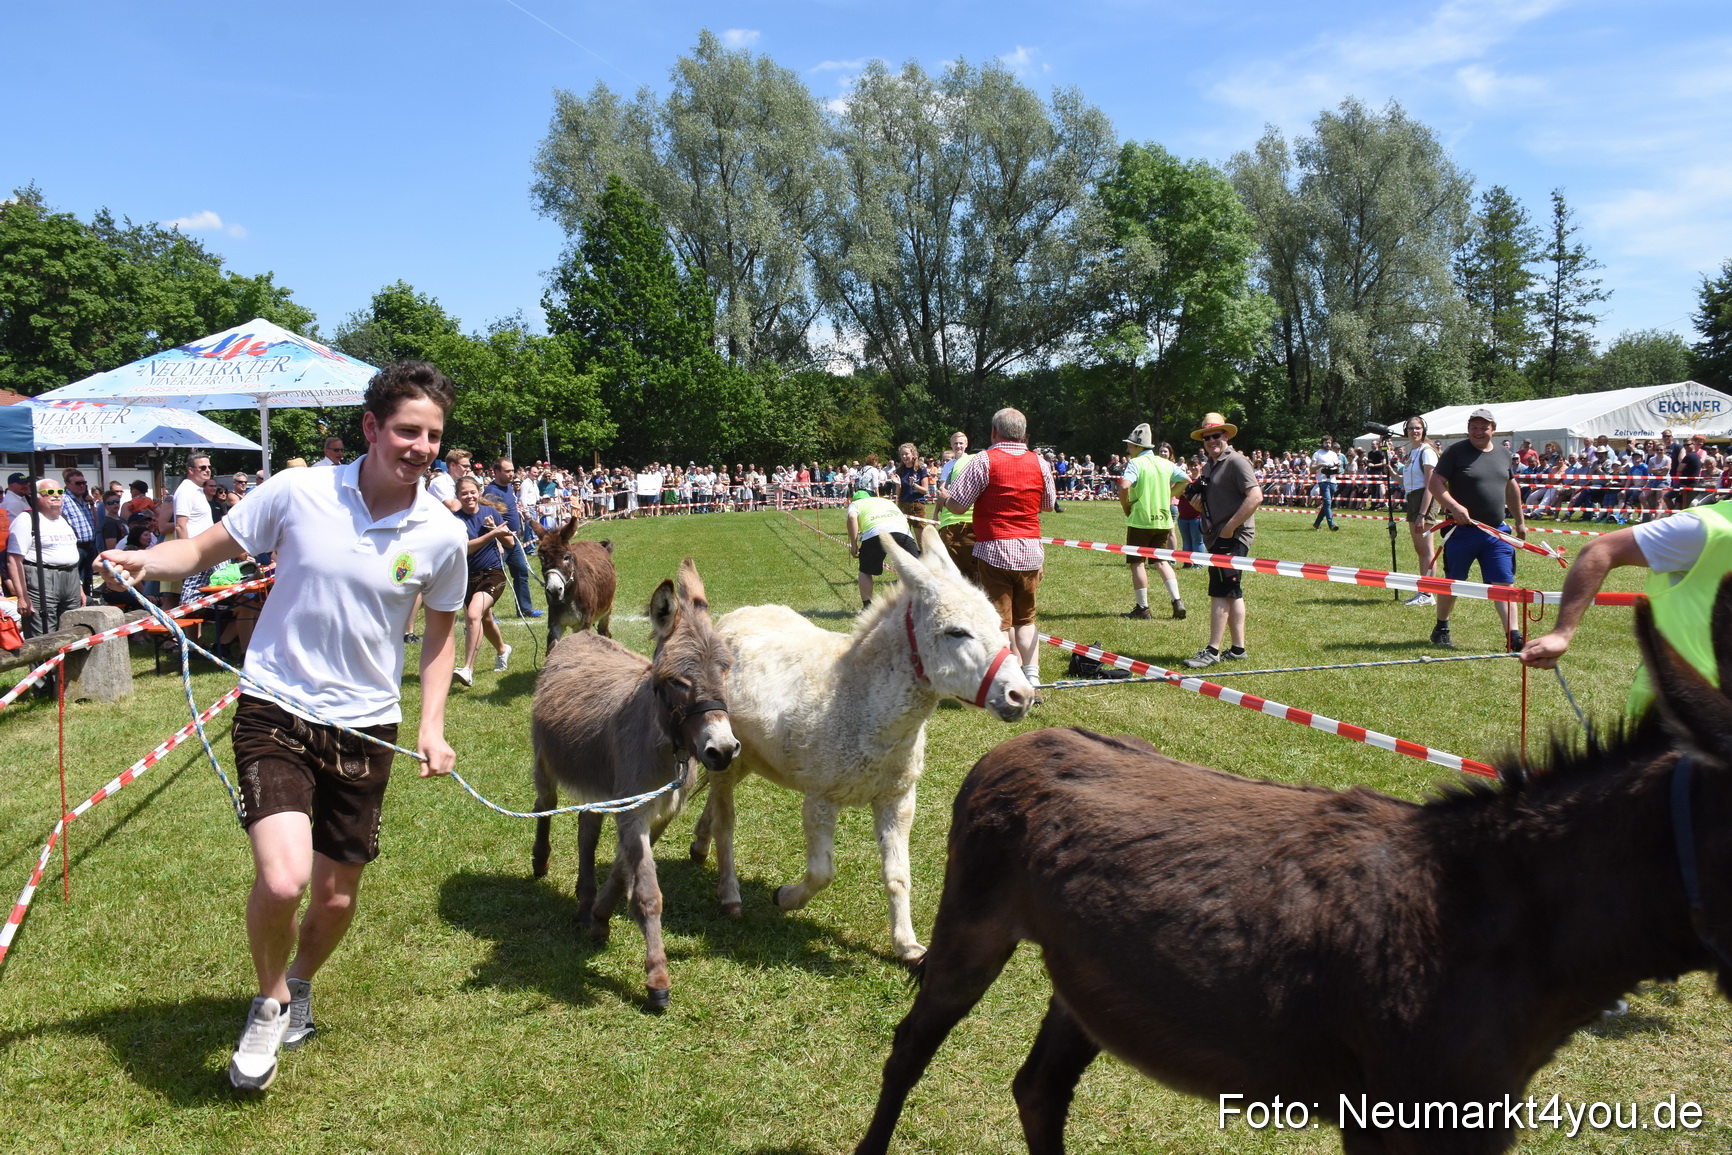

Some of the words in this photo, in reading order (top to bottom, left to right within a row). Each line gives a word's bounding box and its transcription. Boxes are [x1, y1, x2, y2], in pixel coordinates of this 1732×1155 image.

[140, 355, 292, 377] NEUMARKTER
[146, 374, 265, 386] MINERALBRUNNEN
[1658, 400, 1721, 413] EICHNER
[870, 513, 894, 521] JAKO
[1150, 514, 1164, 522] JAO
